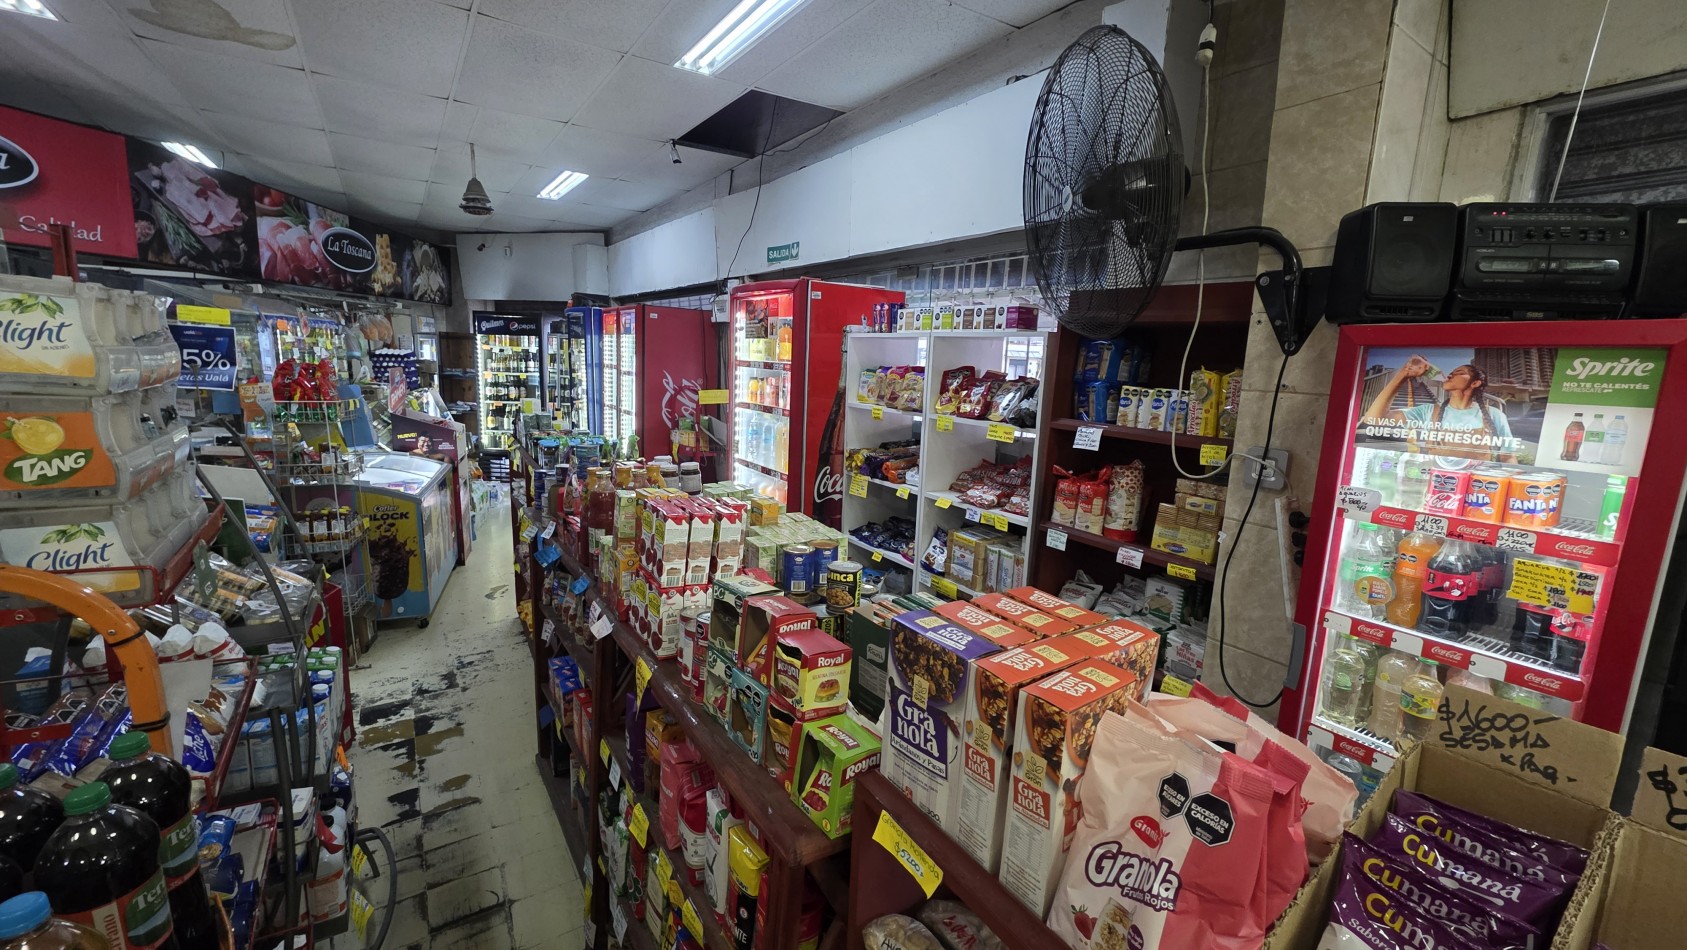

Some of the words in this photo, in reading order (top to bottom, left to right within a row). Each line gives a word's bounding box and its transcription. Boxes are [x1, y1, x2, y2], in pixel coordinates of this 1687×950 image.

[328, 236, 339, 251] La
[341, 239, 372, 260] Toscana
[769, 248, 790, 259] SALIDA
[1566, 357, 1655, 379] Sprite
[1594, 382, 1650, 390] CALENTÉS
[1367, 417, 1376, 426] SI
[1378, 418, 1396, 427] VAS
[1397, 420, 1405, 428] A
[1406, 419, 1441, 432] TOMAR
[1442, 422, 1474, 434] ALGO,
[1365, 426, 1391, 437] QUE
[1392, 427, 1416, 440] SEA
[1420, 430, 1526, 449] REFRESCANTE.
[13, 451, 86, 483] TANG
[1379, 511, 1409, 523] Coca-Cola
[1456, 525, 1490, 537] Coca-Cola
[1555, 541, 1596, 555] Coca-Cola
[1357, 624, 1385, 639] Coca-Cola
[818, 653, 844, 667] Royal
[1431, 646, 1462, 662] Coca-Cola
[1524, 672, 1563, 690] Coca-Cola
[898, 694, 936, 735] Gra
[826, 726, 859, 747] Royal
[897, 716, 939, 758] nola
[968, 747, 990, 771] Gra
[1340, 741, 1366, 757] Coca-Cola
[845, 753, 880, 780] Royal
[928, 758, 946, 775] Pasas
[968, 759, 991, 781] nola
[1018, 781, 1044, 806] Gra
[1018, 792, 1045, 817] nola
[1191, 803, 1220, 822] EXCESO
[1219, 819, 1229, 829] EN
[1191, 810, 1225, 834] CALORÍAS
[1417, 815, 1545, 882] Cumaná
[1086, 842, 1180, 900] Granola
[1403, 834, 1521, 903] Cumaná
[1145, 893, 1174, 911] Rojos
